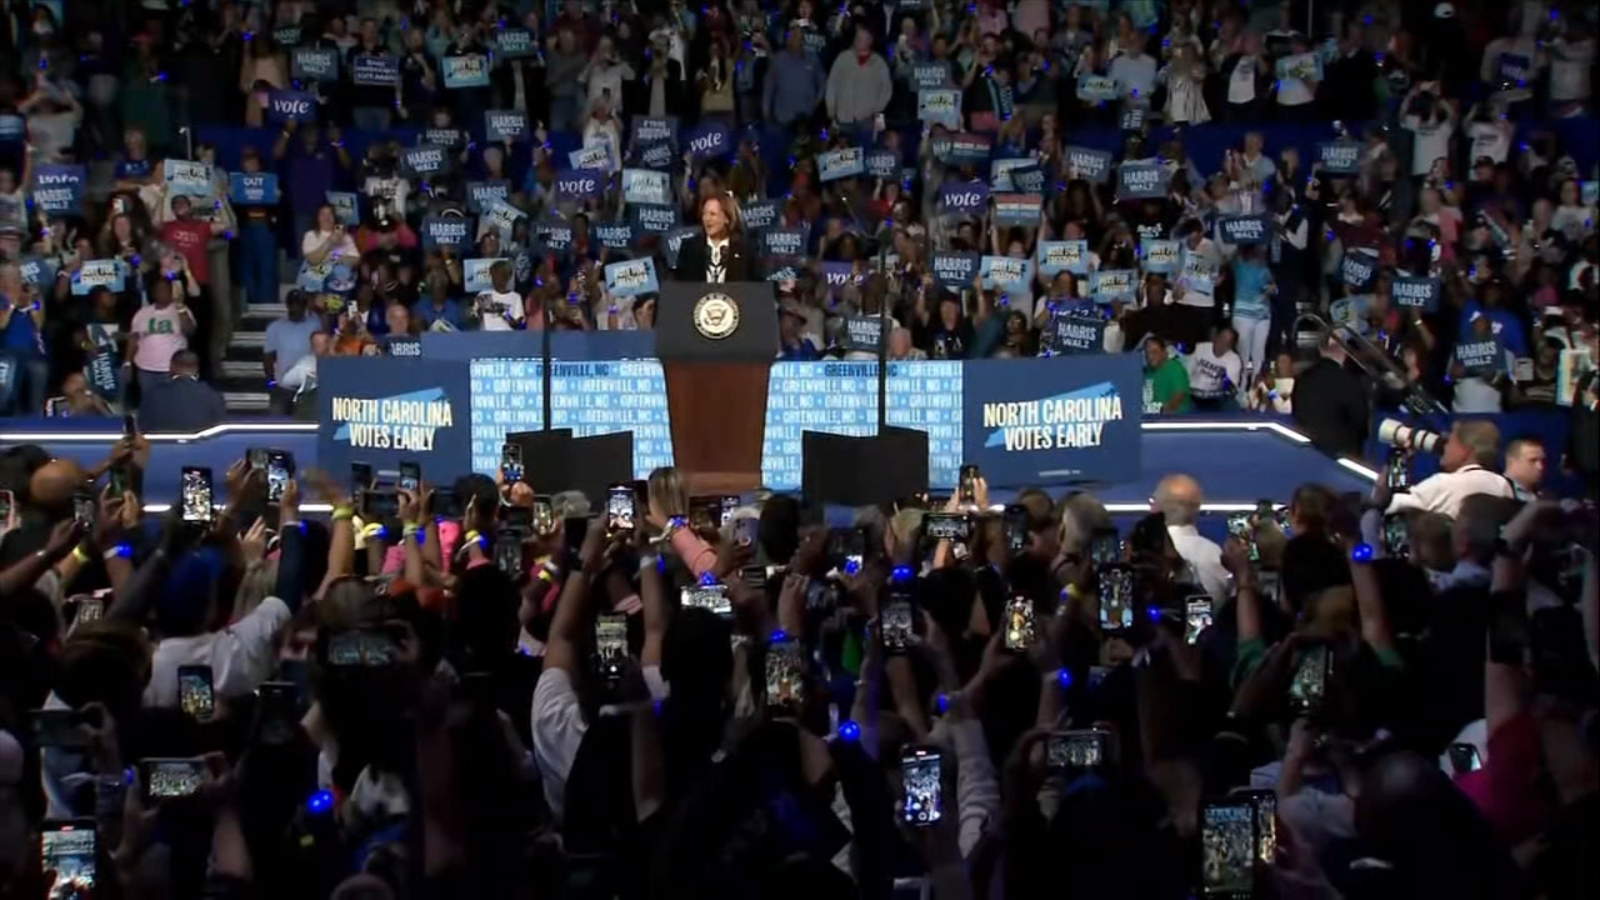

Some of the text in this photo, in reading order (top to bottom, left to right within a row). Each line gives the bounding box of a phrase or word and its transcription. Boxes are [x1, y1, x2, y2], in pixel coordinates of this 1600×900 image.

[273, 97, 310, 115] vote
[490, 115, 525, 129] HARRIS
[690, 131, 722, 152] vote
[407, 149, 443, 166] HARRIS
[415, 160, 440, 173] WALZ
[1124, 169, 1160, 183] HARRIS
[473, 185, 508, 200] HARRIS
[559, 177, 595, 193] vote
[1130, 181, 1155, 192] WALZ
[945, 191, 981, 208] vote
[639, 208, 675, 223] HARRIS
[430, 222, 466, 236] HARRIS
[596, 226, 631, 240] HARRIS
[644, 221, 670, 231] WALZ
[1225, 219, 1263, 234] HARRIS
[435, 234, 460, 246] WALZ
[602, 238, 628, 249] WALZ
[766, 232, 802, 247] HARRIS
[1232, 231, 1258, 241] WALZ
[934, 256, 972, 271] HARRIS
[826, 271, 864, 286] voe
[939, 270, 966, 281] WALZ
[1393, 282, 1432, 298] HARRIS
[1398, 296, 1425, 307] WALZ
[1058, 322, 1097, 340] HARRIS
[391, 342, 421, 356] ARRIS
[1063, 338, 1090, 349] WALZ
[1456, 341, 1496, 358] HARRIS
[1464, 356, 1493, 367] WALZ
[535, 364, 595, 379] GEENVILLE,
[867, 379, 925, 393] GRENVILLE,
[535, 395, 594, 409] GENVILLE,
[332, 397, 453, 427] NORTH CAROLINA
[867, 410, 925, 424] GRENVILLE,
[983, 396, 1123, 427] NORTH CAROLINA
[350, 423, 436, 451] VOTES EARLY
[1004, 422, 1104, 451] VOTES EARLY
